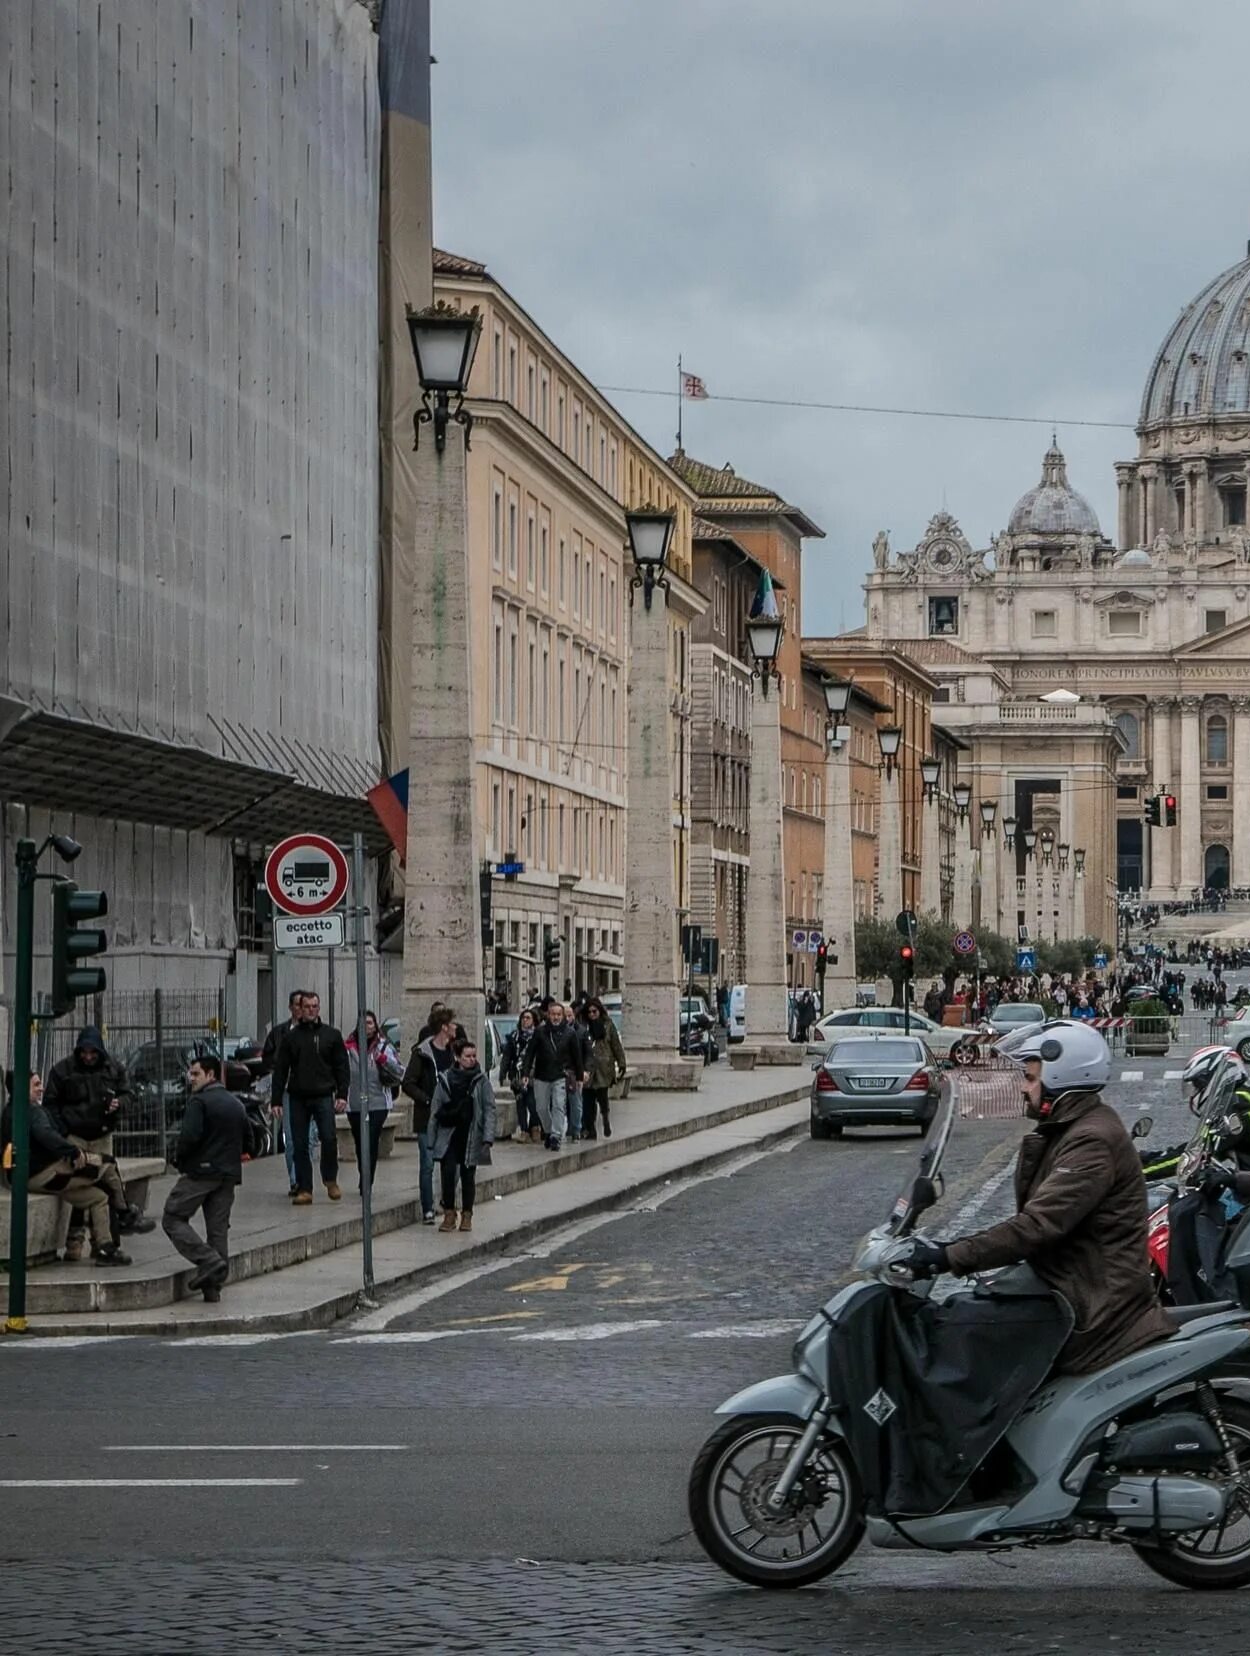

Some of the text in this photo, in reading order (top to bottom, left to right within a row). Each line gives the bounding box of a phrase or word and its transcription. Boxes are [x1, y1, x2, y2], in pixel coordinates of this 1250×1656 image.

[297, 886, 318, 898] 6 m
[286, 920, 332, 932] eccetto
[296, 933, 323, 945] atac
